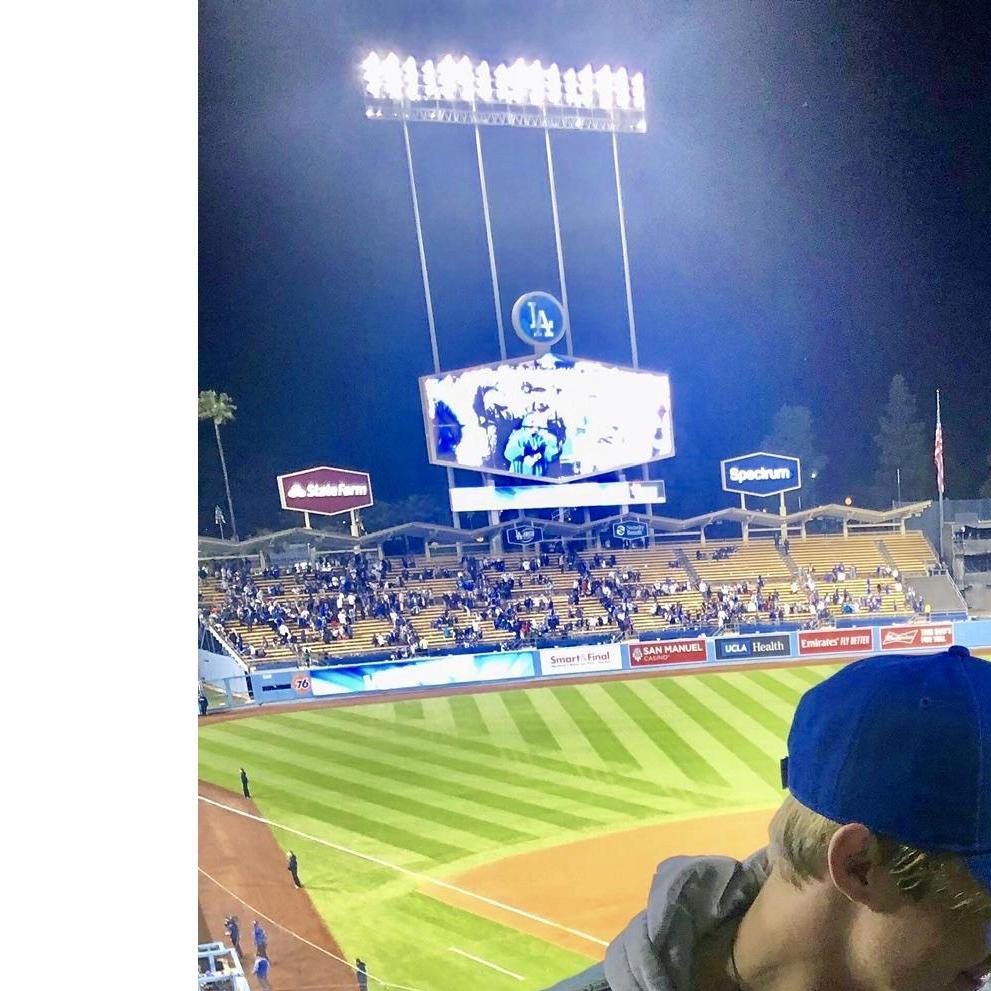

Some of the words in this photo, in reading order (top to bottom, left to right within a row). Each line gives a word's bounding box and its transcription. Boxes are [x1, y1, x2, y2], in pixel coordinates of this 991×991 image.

[527, 301, 554, 337] LA
[729, 466, 791, 483] Spectrum
[643, 646, 662, 655] SAN
[664, 643, 703, 654] MANUEL
[725, 644, 747, 653] UCLA
[752, 641, 784, 652] Health
[801, 638, 838, 648] Emirates
[297, 679, 309, 689] 76
